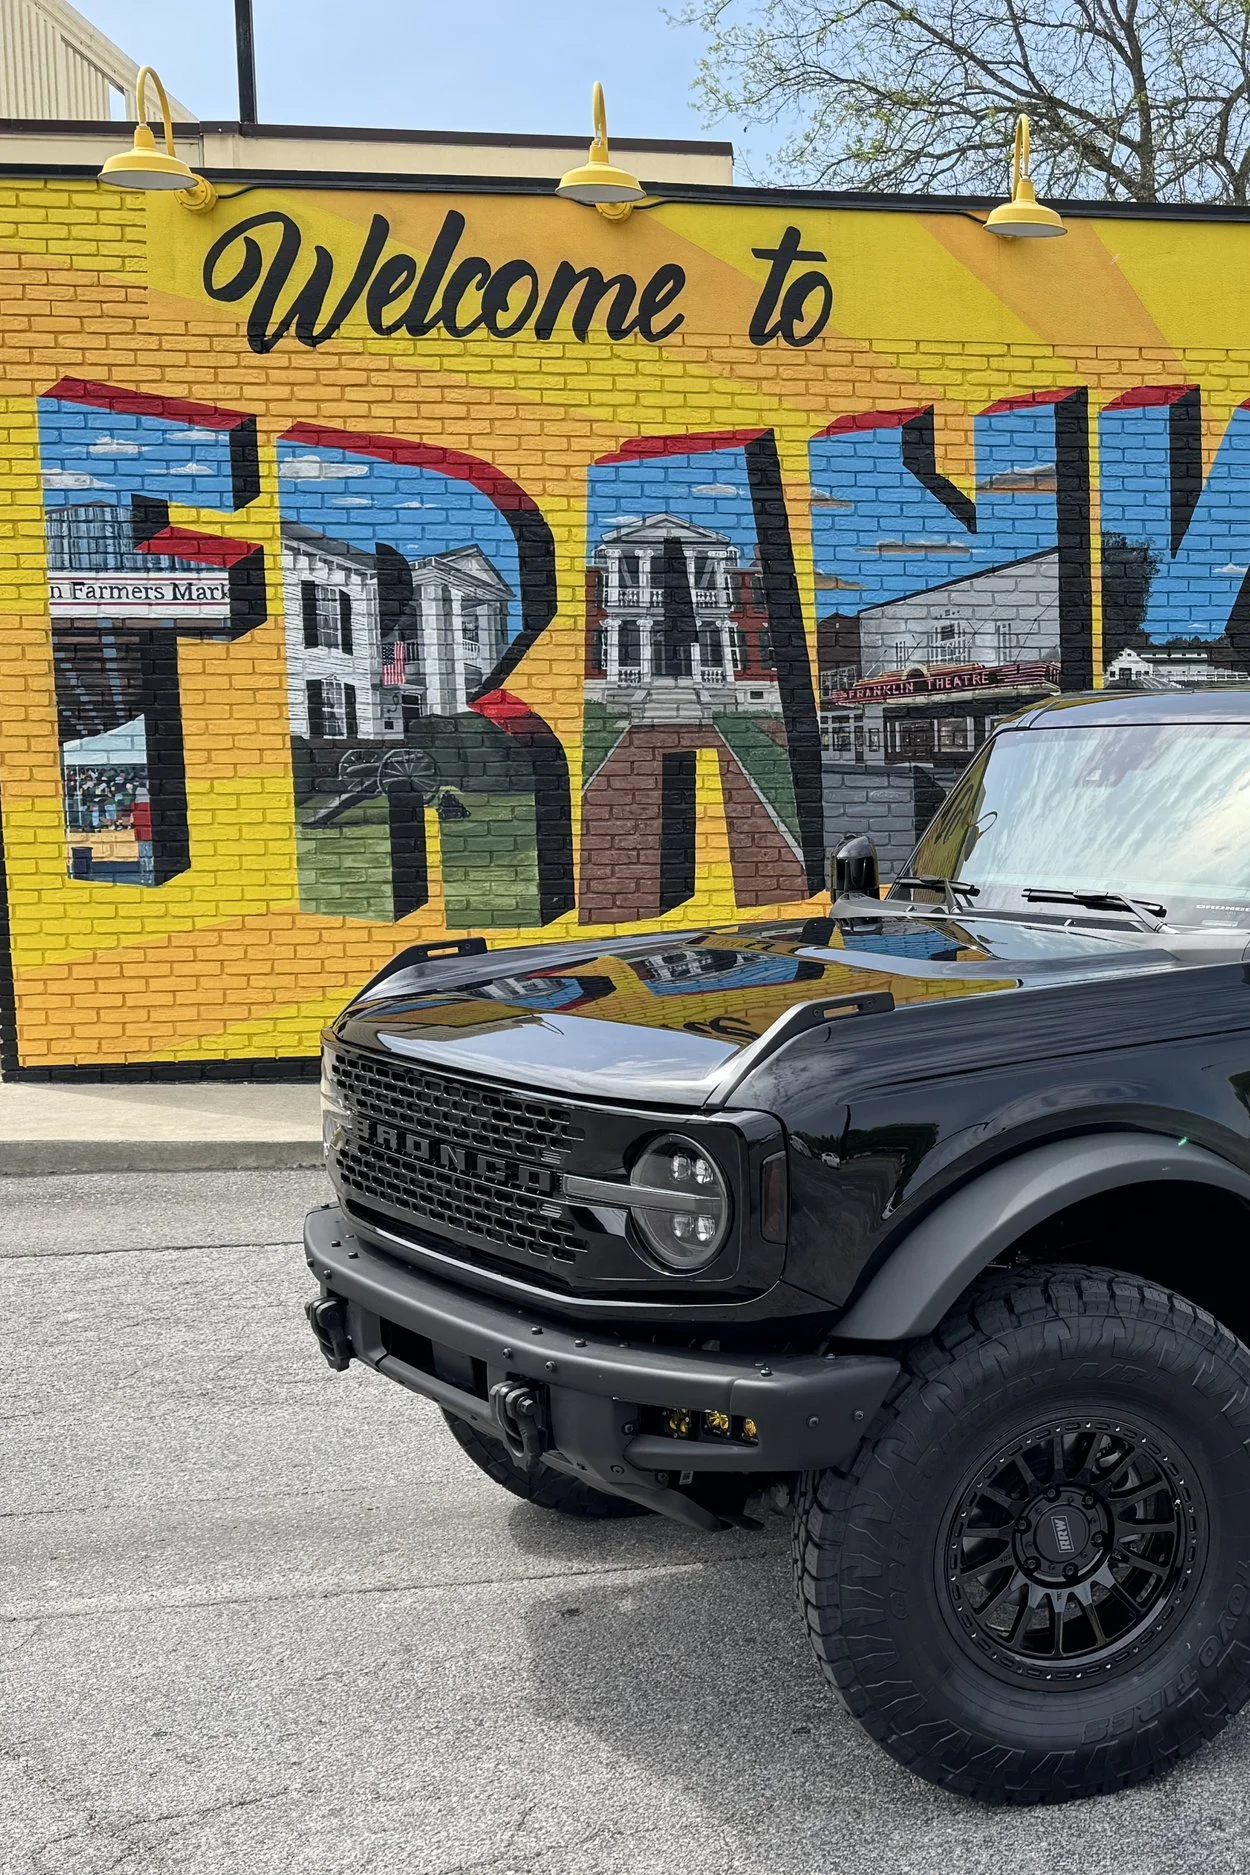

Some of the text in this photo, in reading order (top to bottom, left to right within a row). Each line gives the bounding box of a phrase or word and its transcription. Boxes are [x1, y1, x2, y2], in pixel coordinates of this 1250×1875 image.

[203, 210, 834, 354] Welcome to
[70, 582, 165, 600] Farmers
[848, 671, 990, 699] FRANKLIN THEATRE
[351, 1118, 552, 1193] BRONCO
[1054, 1518, 1072, 1551] RRW
[1081, 1664, 1199, 1745] TIRES
